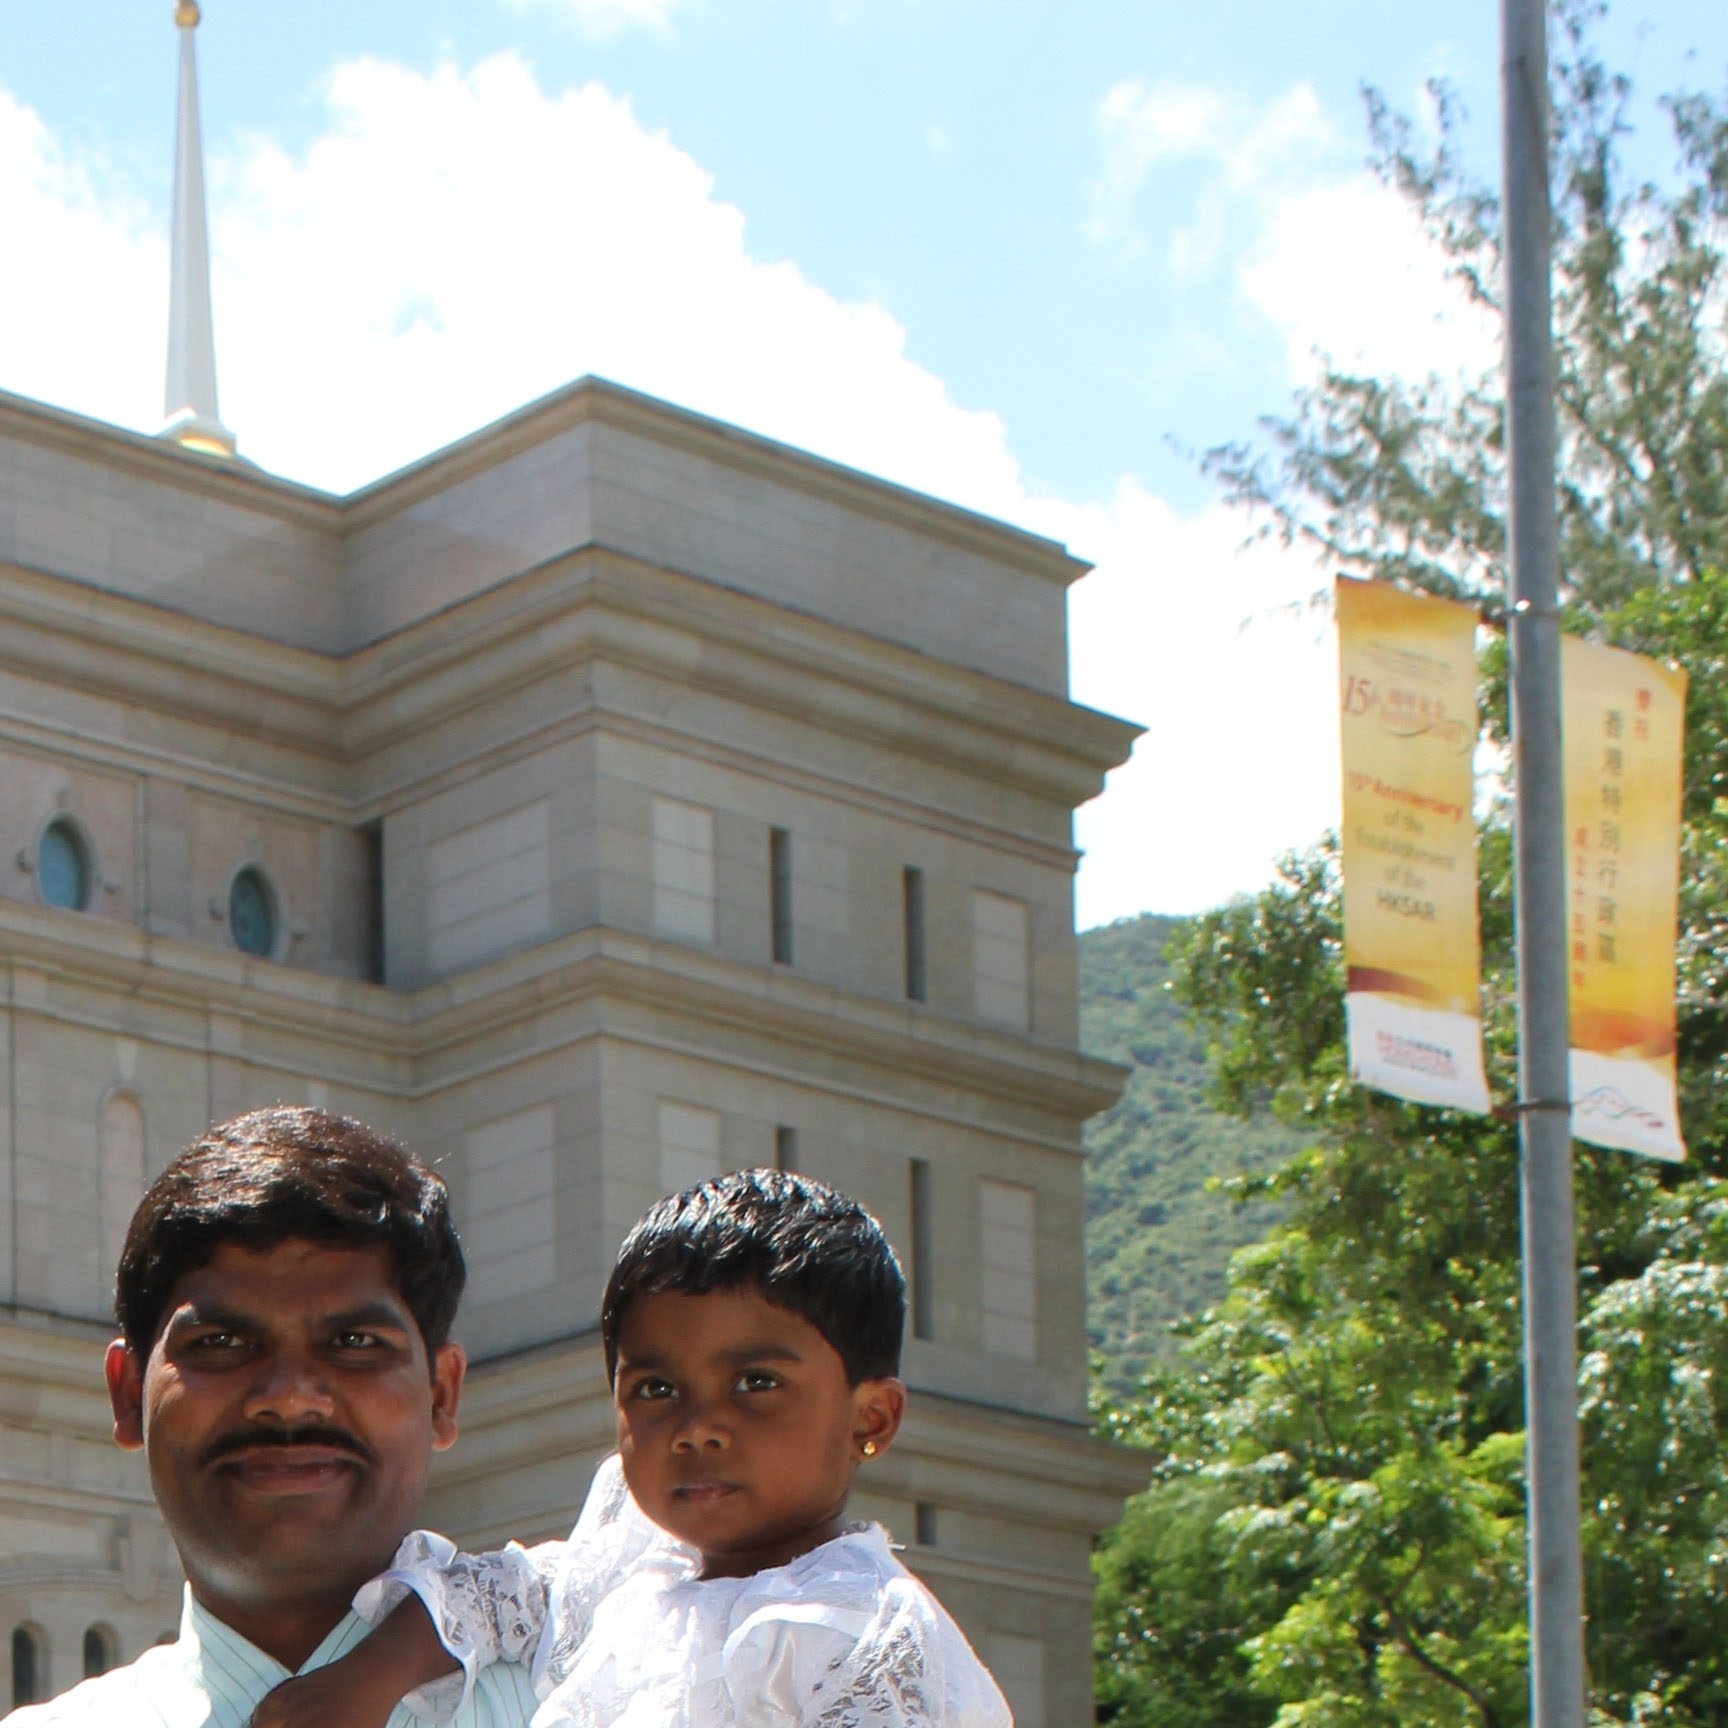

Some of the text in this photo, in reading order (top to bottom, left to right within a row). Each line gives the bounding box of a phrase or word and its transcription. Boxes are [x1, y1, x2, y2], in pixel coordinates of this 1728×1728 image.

[1372, 777, 1464, 823] Anniversary
[1383, 809, 1425, 836] of the
[1383, 864, 1400, 882] of
[1376, 889, 1437, 921] HKSAR
